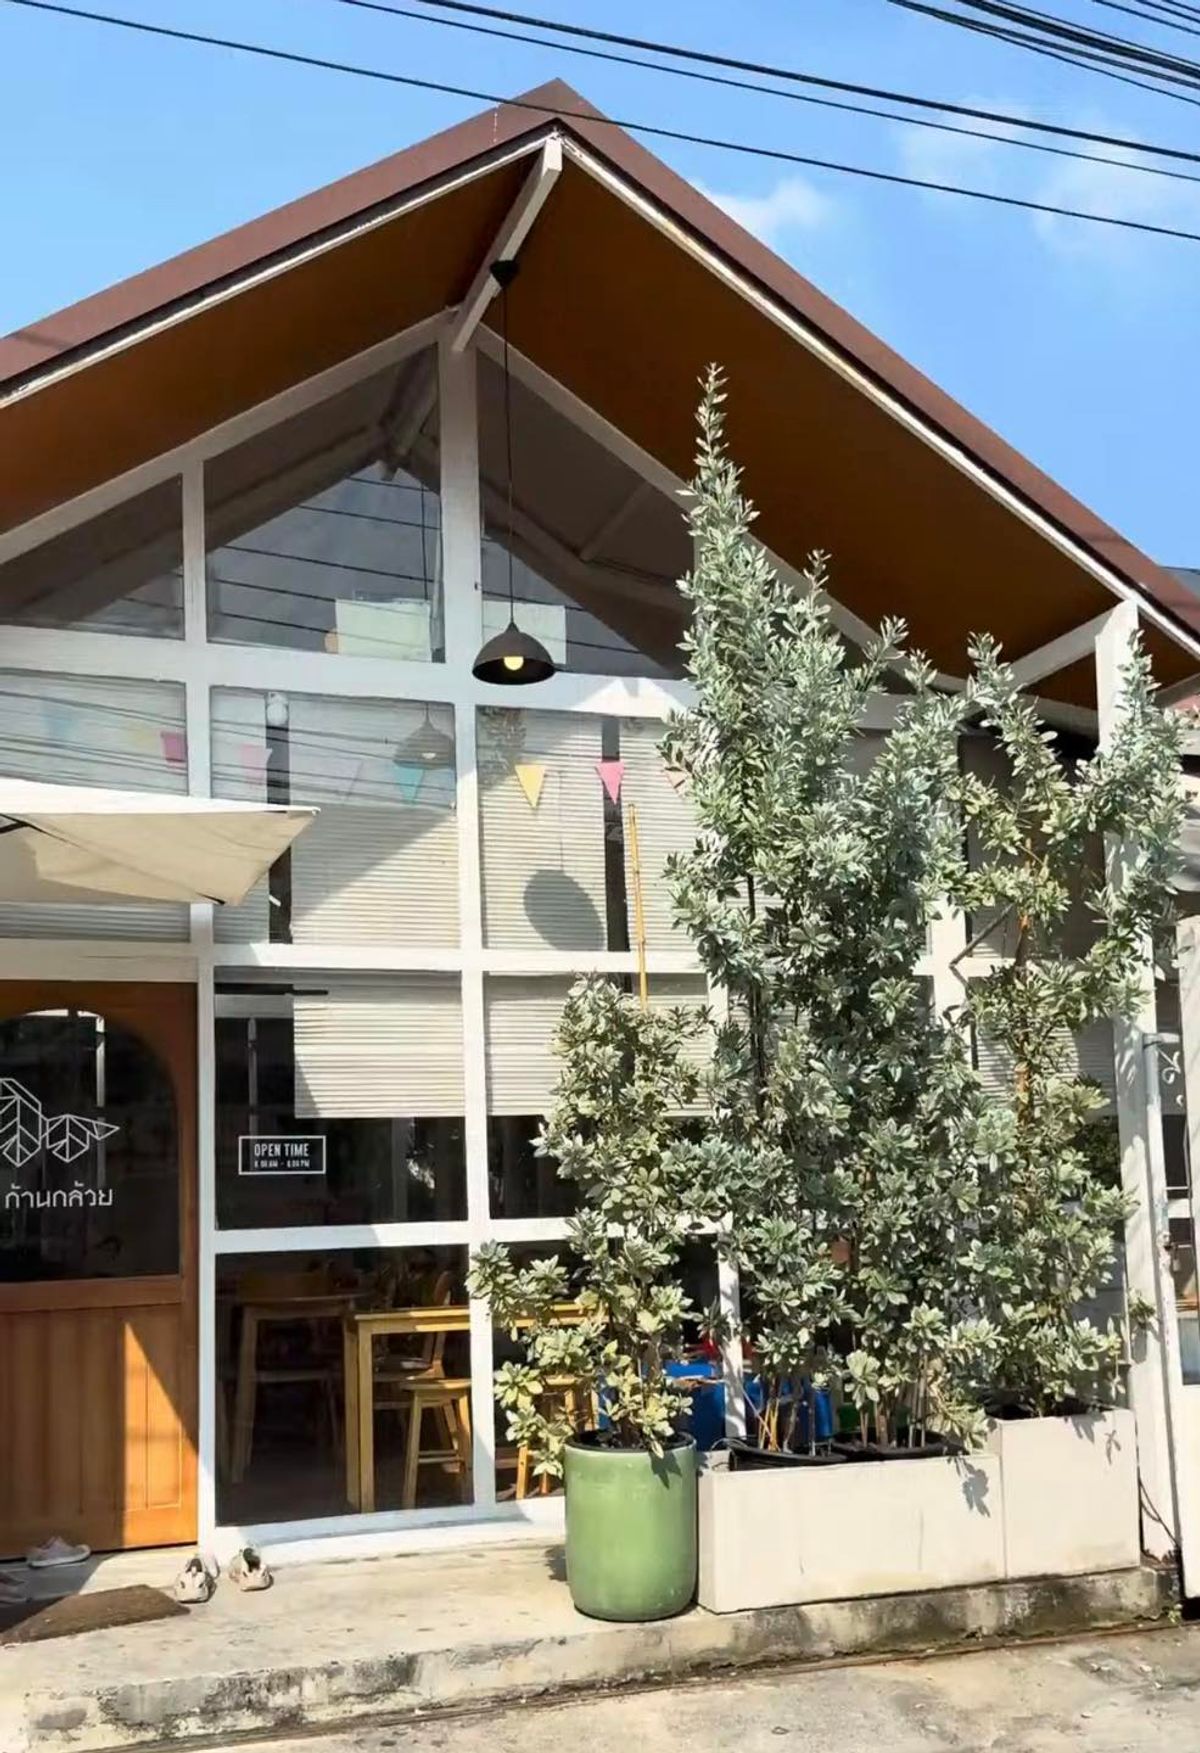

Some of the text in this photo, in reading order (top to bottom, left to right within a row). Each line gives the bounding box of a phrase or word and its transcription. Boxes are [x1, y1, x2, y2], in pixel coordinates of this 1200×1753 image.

[254, 1143, 309, 1157] OPEN TIME
[5, 1180, 113, 1208] ก้านกล้วย
